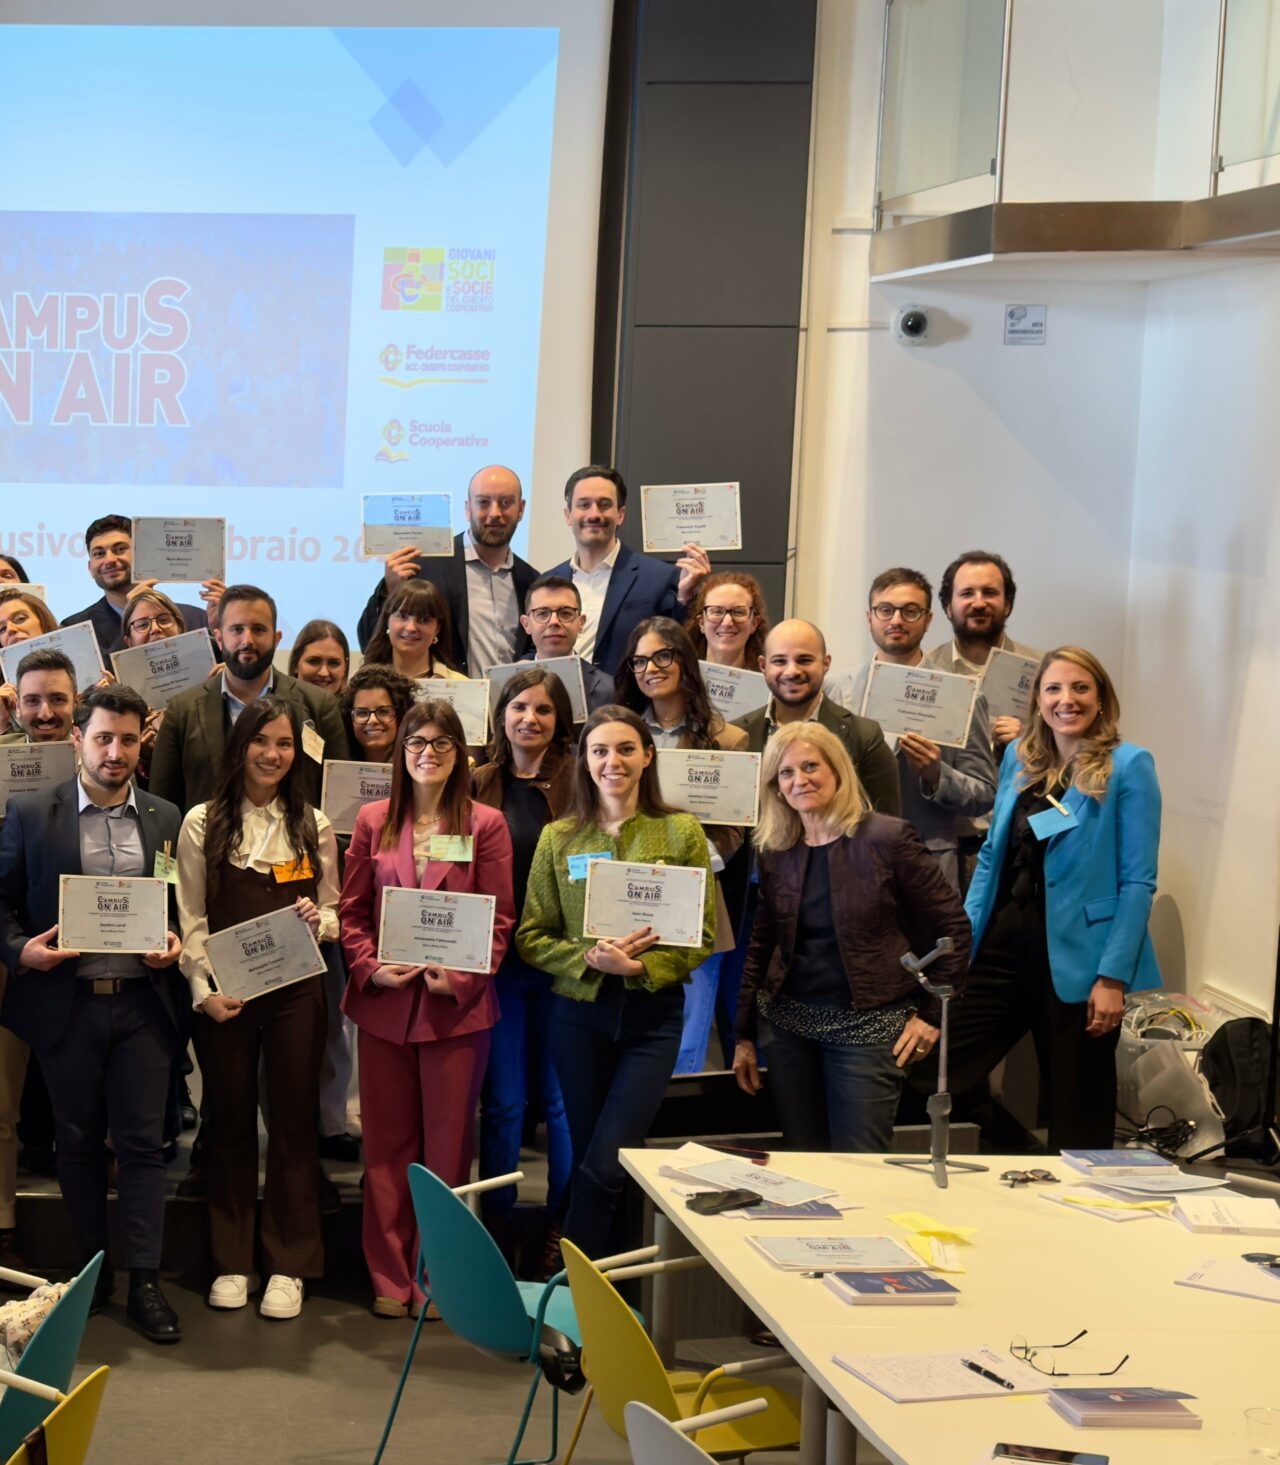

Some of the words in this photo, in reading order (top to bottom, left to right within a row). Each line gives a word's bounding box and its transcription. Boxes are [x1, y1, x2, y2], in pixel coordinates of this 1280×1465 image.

[448, 249, 496, 261] GIOVANI
[447, 260, 495, 281] SOCI
[452, 281, 494, 295] SOCIE
[406, 345, 490, 361] Federcasse
[50, 350, 191, 428] AIR
[408, 420, 452, 432] Scuola
[408, 434, 489, 449] Cooperativa
[676, 508, 687, 516] ON
[689, 507, 704, 515] AIR
[151, 663, 164, 674] ON
[165, 661, 180, 670] AIR
[904, 691, 918, 699] ON
[919, 694, 937, 704] AIR
[10, 761, 41, 769] CAMPUS
[10, 769, 24, 777] ON
[26, 768, 41, 777] AIR
[687, 768, 720, 776] CAMPUS
[703, 775, 721, 784] AIR
[360, 788, 372, 796] ON
[375, 788, 390, 796] AIR
[627, 883, 662, 892] CAMPUS
[97, 895, 129, 903] CAMPUS
[627, 891, 641, 900] ON
[643, 892, 662, 900] AIR
[97, 903, 111, 912] ON
[113, 903, 130, 912] AIR
[420, 909, 453, 919] CAMPUS
[420, 917, 435, 926] ON
[436, 918, 454, 927] AIR
[244, 946, 259, 957] ON
[259, 940, 275, 951] AIR
